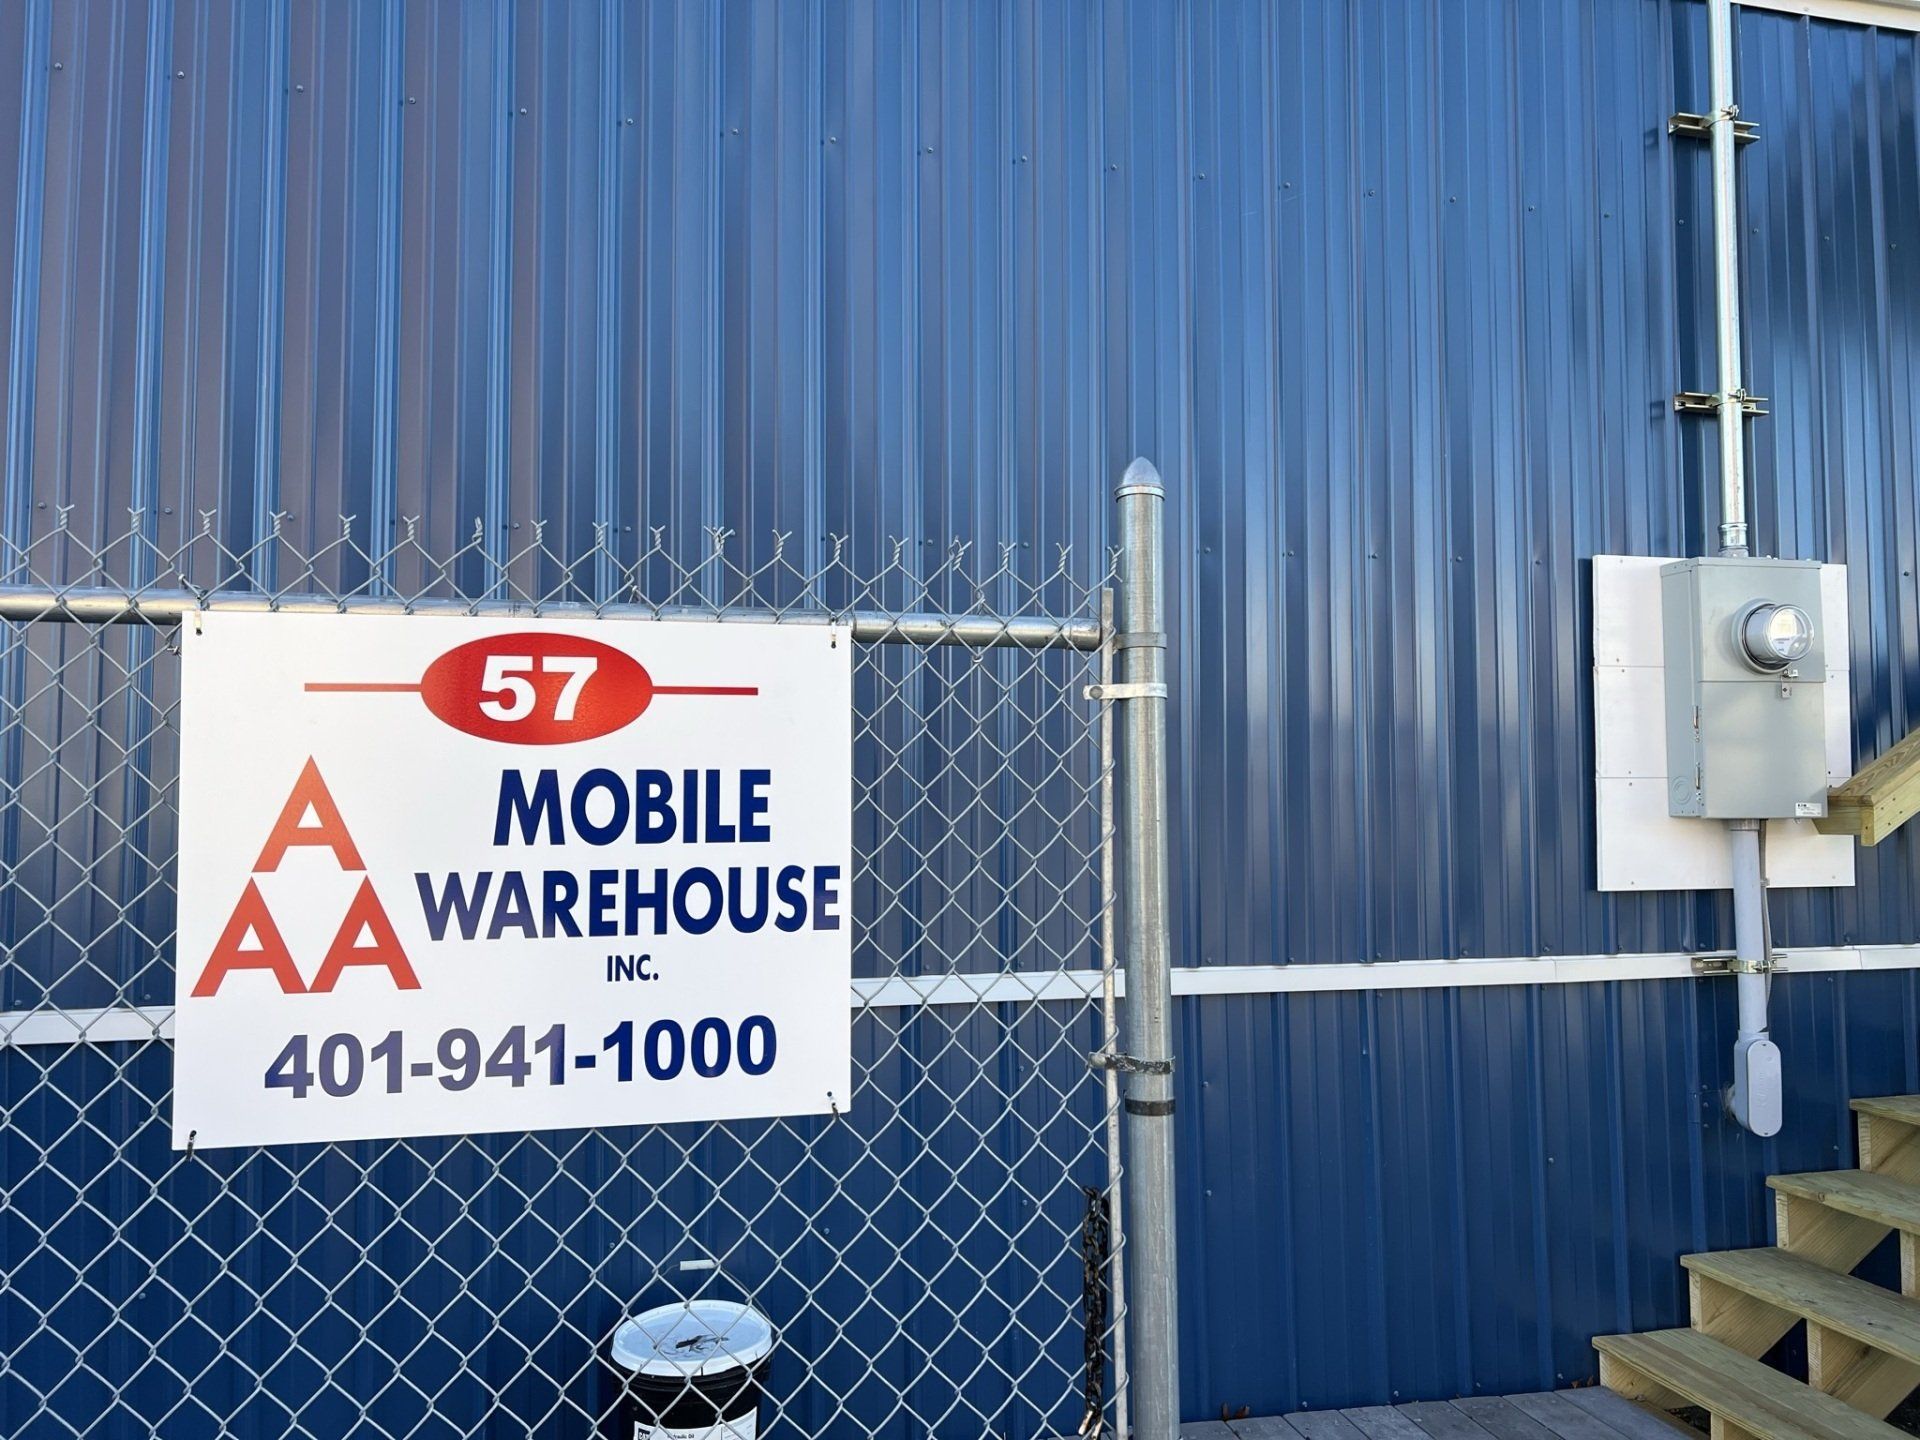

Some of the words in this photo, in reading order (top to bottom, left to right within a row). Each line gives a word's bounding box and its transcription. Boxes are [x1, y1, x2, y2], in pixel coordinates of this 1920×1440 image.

[479, 656, 597, 721] 57
[251, 755, 366, 873] A
[493, 768, 771, 846] MOBILE
[414, 864, 841, 941] WAREHOUSE
[606, 953, 659, 983] INC.
[264, 1015, 777, 1099] 401-941-1000
